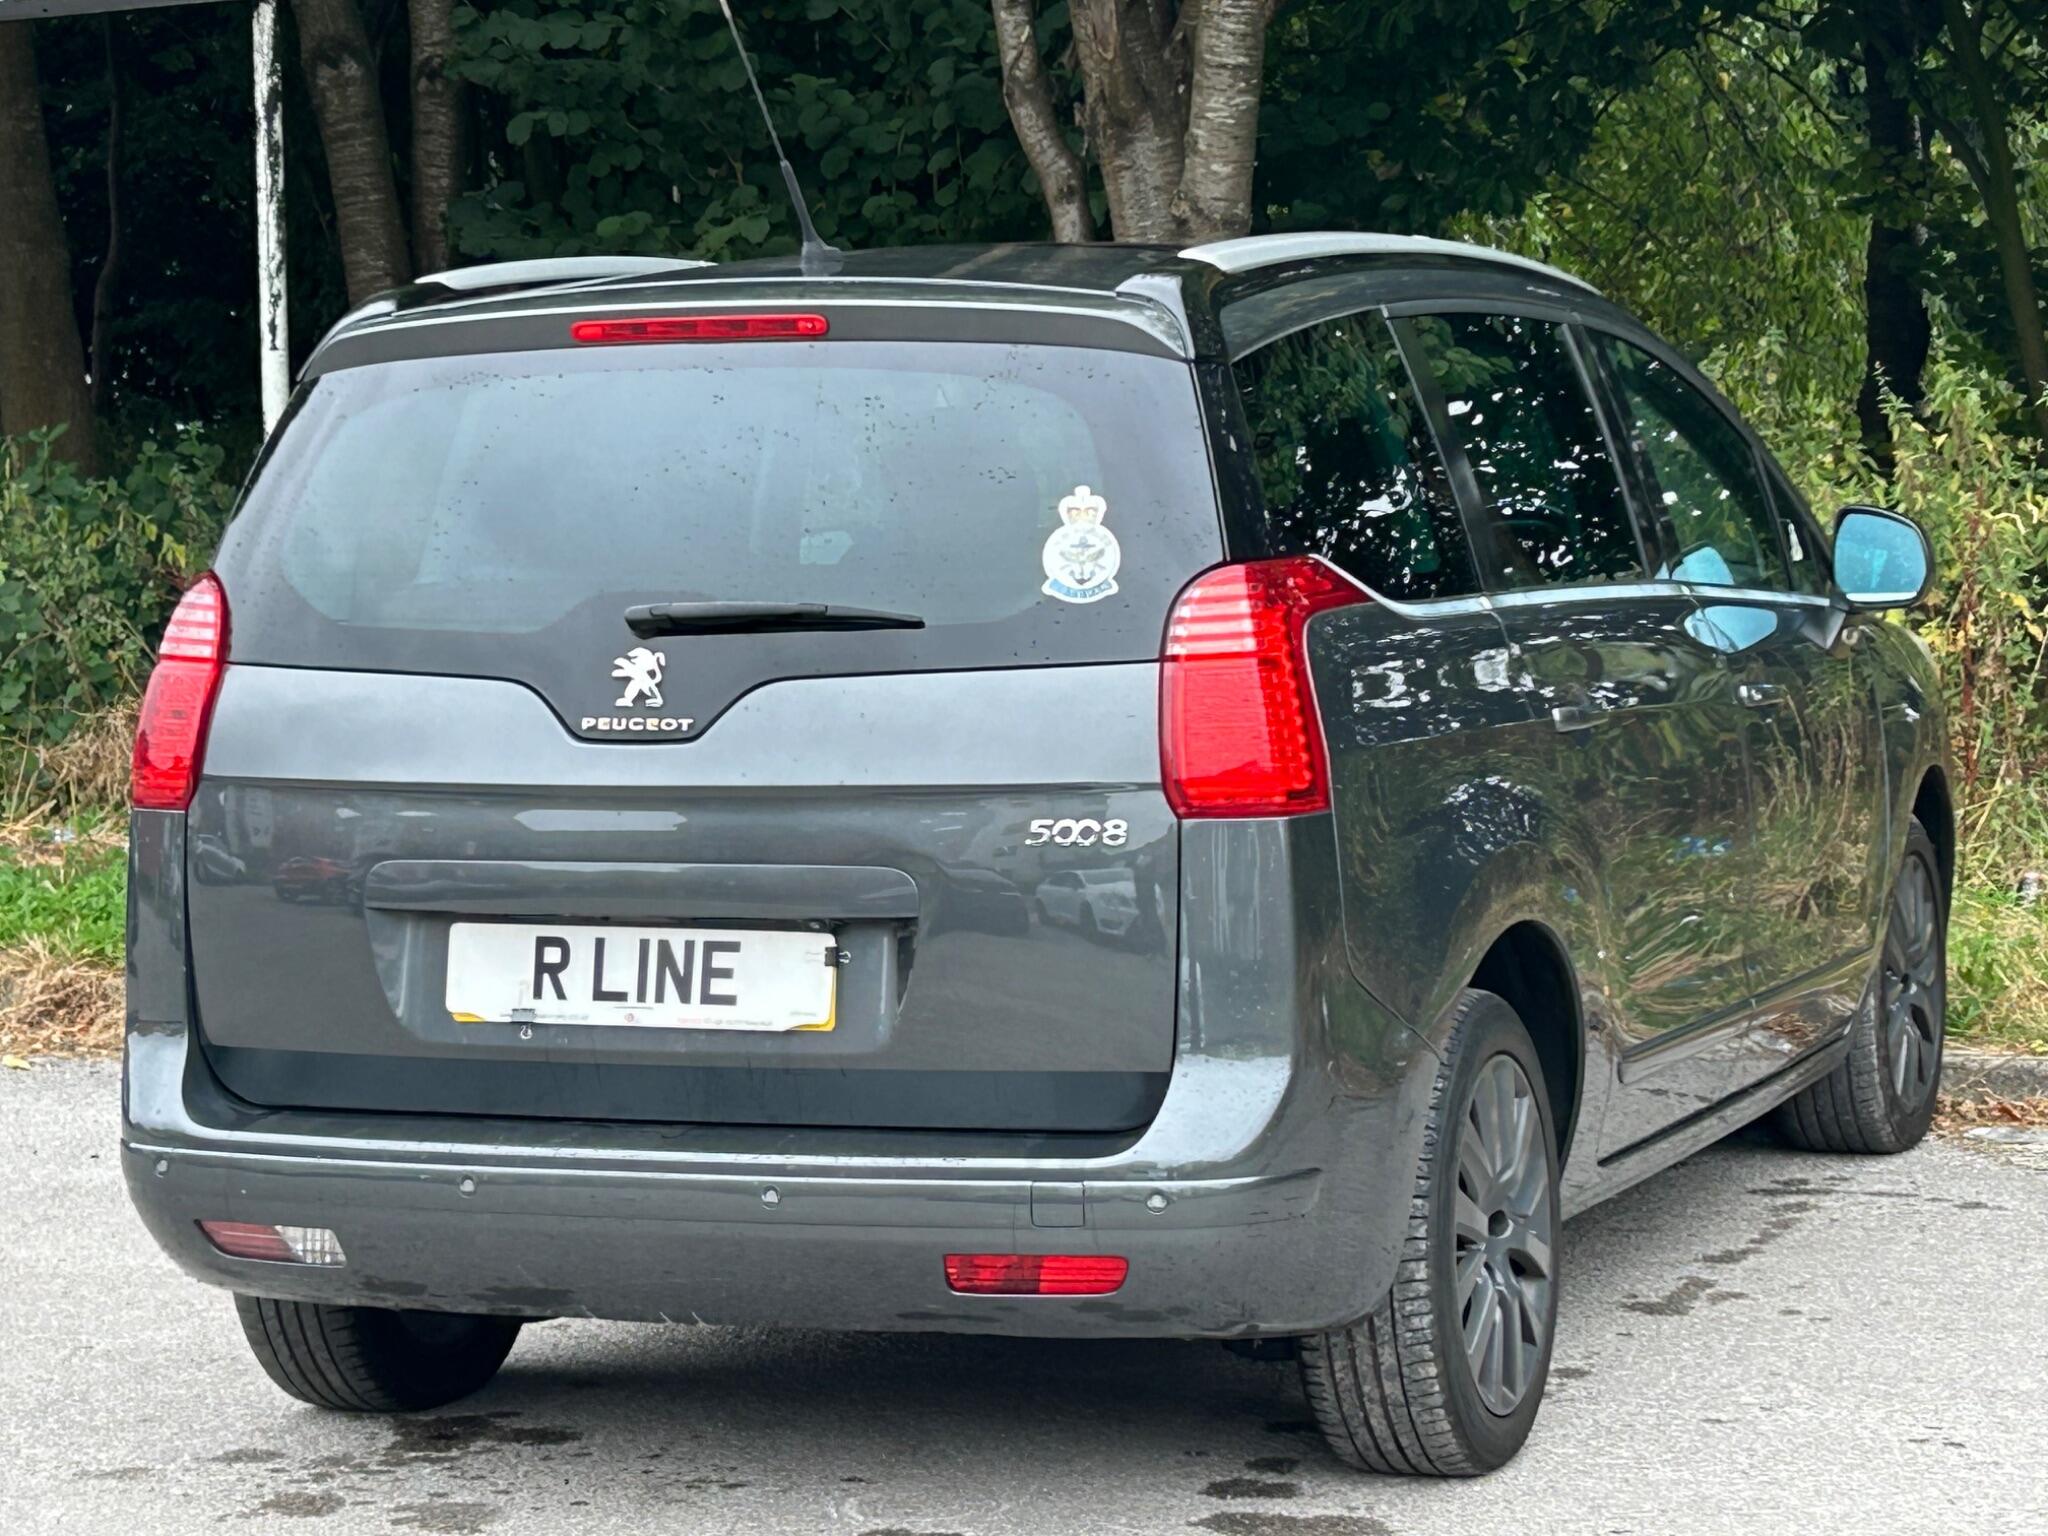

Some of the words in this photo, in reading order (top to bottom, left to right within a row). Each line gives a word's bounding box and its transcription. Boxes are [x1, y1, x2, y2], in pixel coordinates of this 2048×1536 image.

[581, 717, 694, 731] PEUGEOT
[1025, 818, 1128, 846] 5008
[533, 935, 571, 1001] R
[592, 937, 741, 1006] LINE
